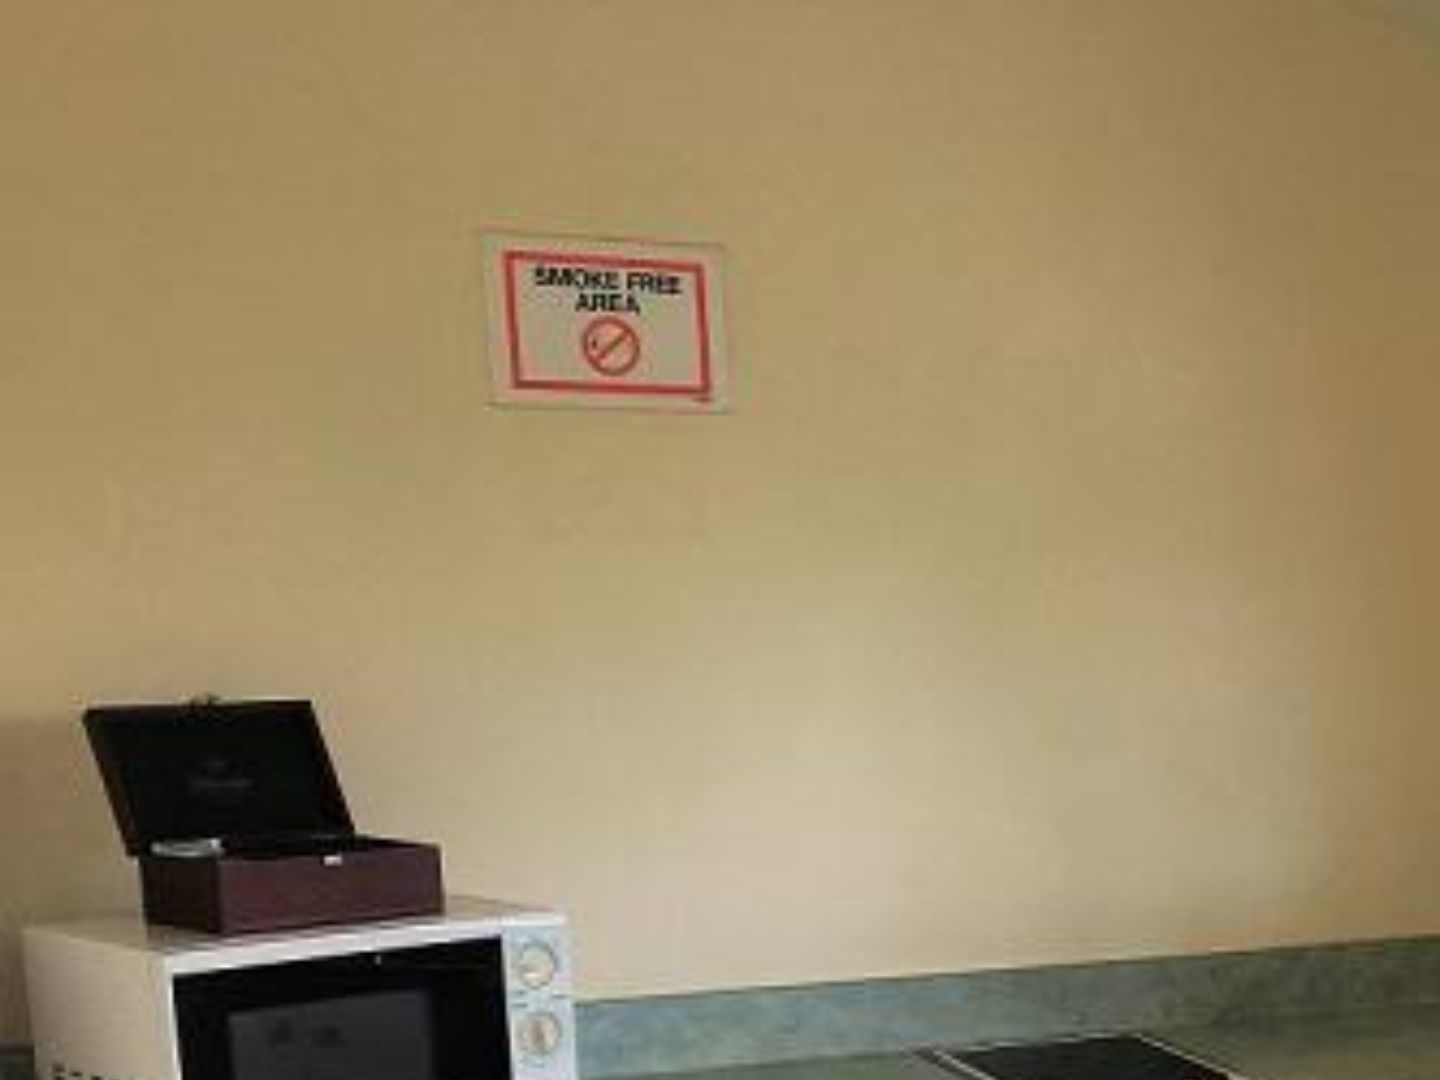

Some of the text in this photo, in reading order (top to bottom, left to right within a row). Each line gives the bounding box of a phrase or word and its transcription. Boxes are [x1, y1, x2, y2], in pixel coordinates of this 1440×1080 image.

[534, 266, 683, 294] SMOKE FREE
[575, 292, 641, 314] AREA
